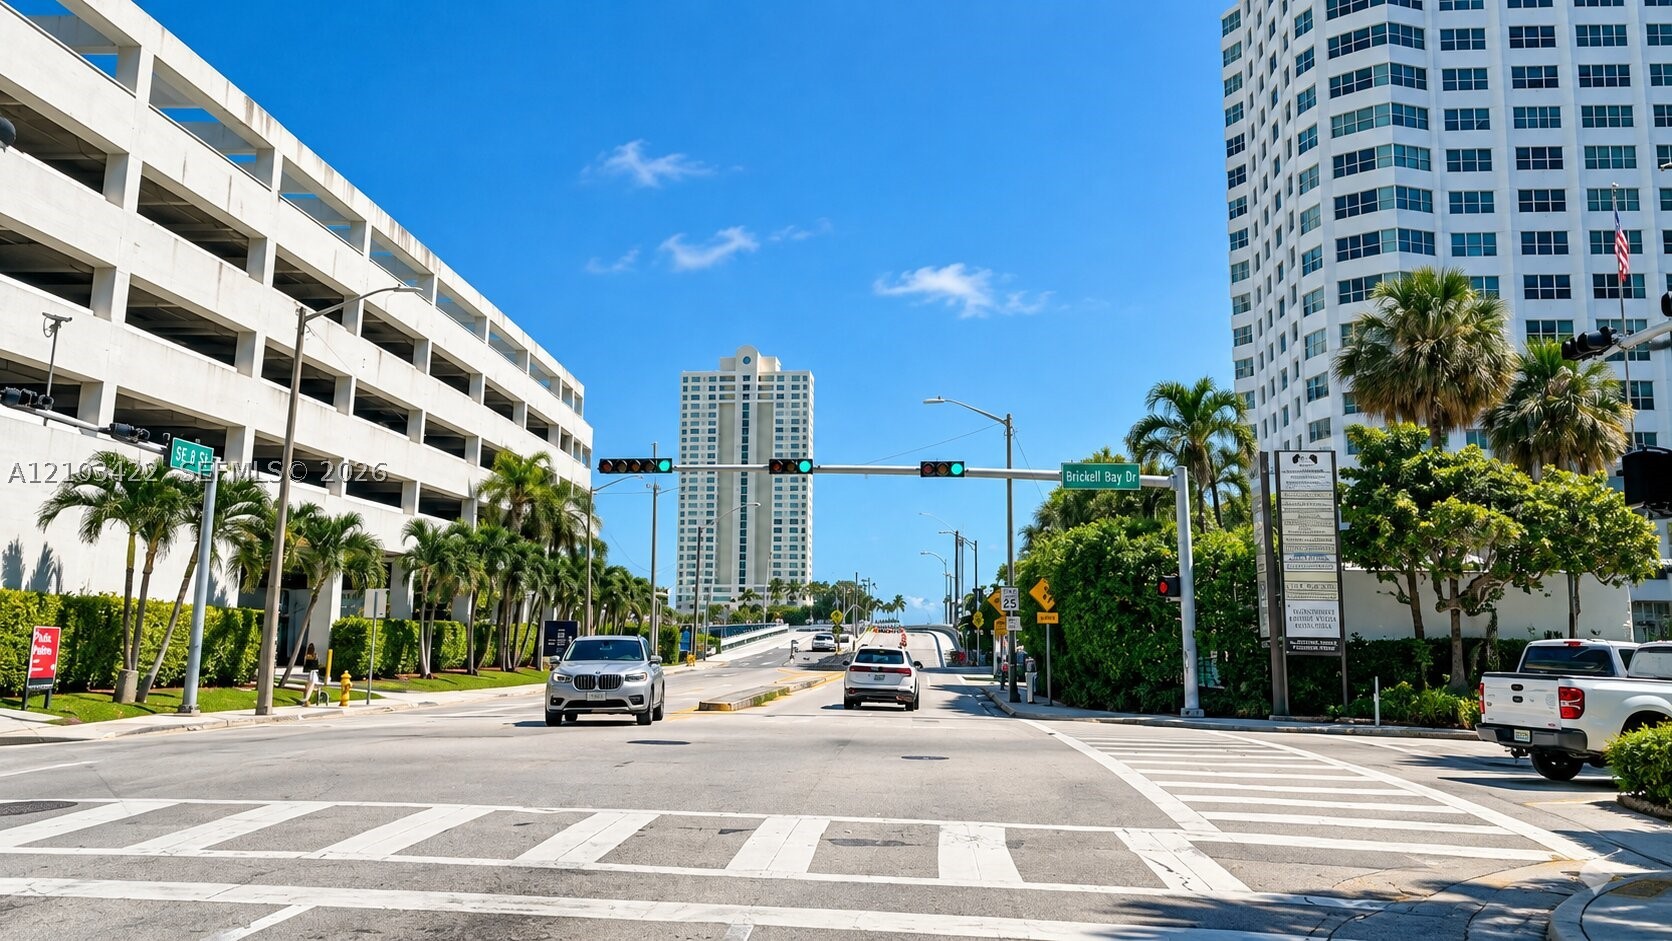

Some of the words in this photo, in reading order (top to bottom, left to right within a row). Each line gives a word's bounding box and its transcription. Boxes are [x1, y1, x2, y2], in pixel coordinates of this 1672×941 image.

[176, 446, 188, 462] SE
[191, 450, 196, 465] 8
[200, 452, 208, 467] St
[1066, 470, 1101, 482] Brickell
[1104, 471, 1122, 486] Bay
[1126, 471, 1136, 482] Dr
[1003, 599, 1016, 608] 25
